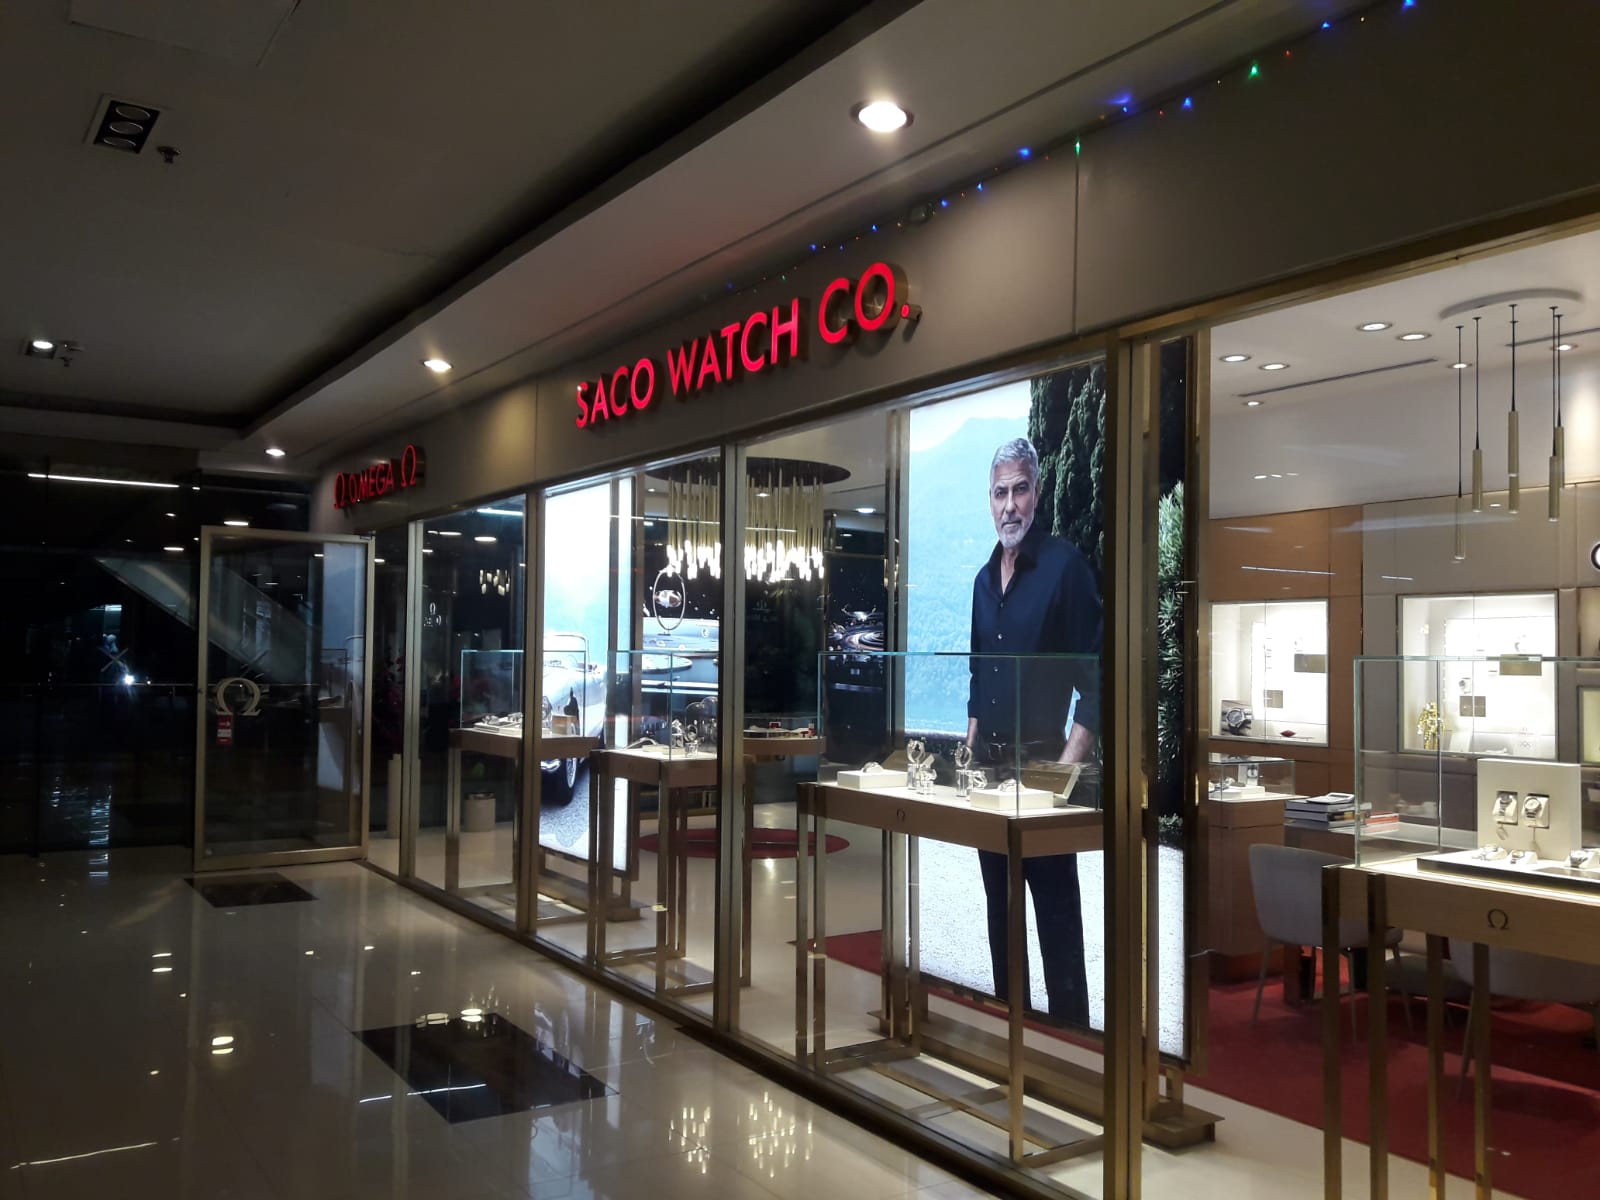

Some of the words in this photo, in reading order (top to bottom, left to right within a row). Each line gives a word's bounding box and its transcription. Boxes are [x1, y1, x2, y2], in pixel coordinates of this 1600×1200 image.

[575, 357, 655, 429] SACO
[666, 297, 799, 396] WATCH
[817, 261, 911, 345] CO.
[349, 462, 394, 505] OMEGA
